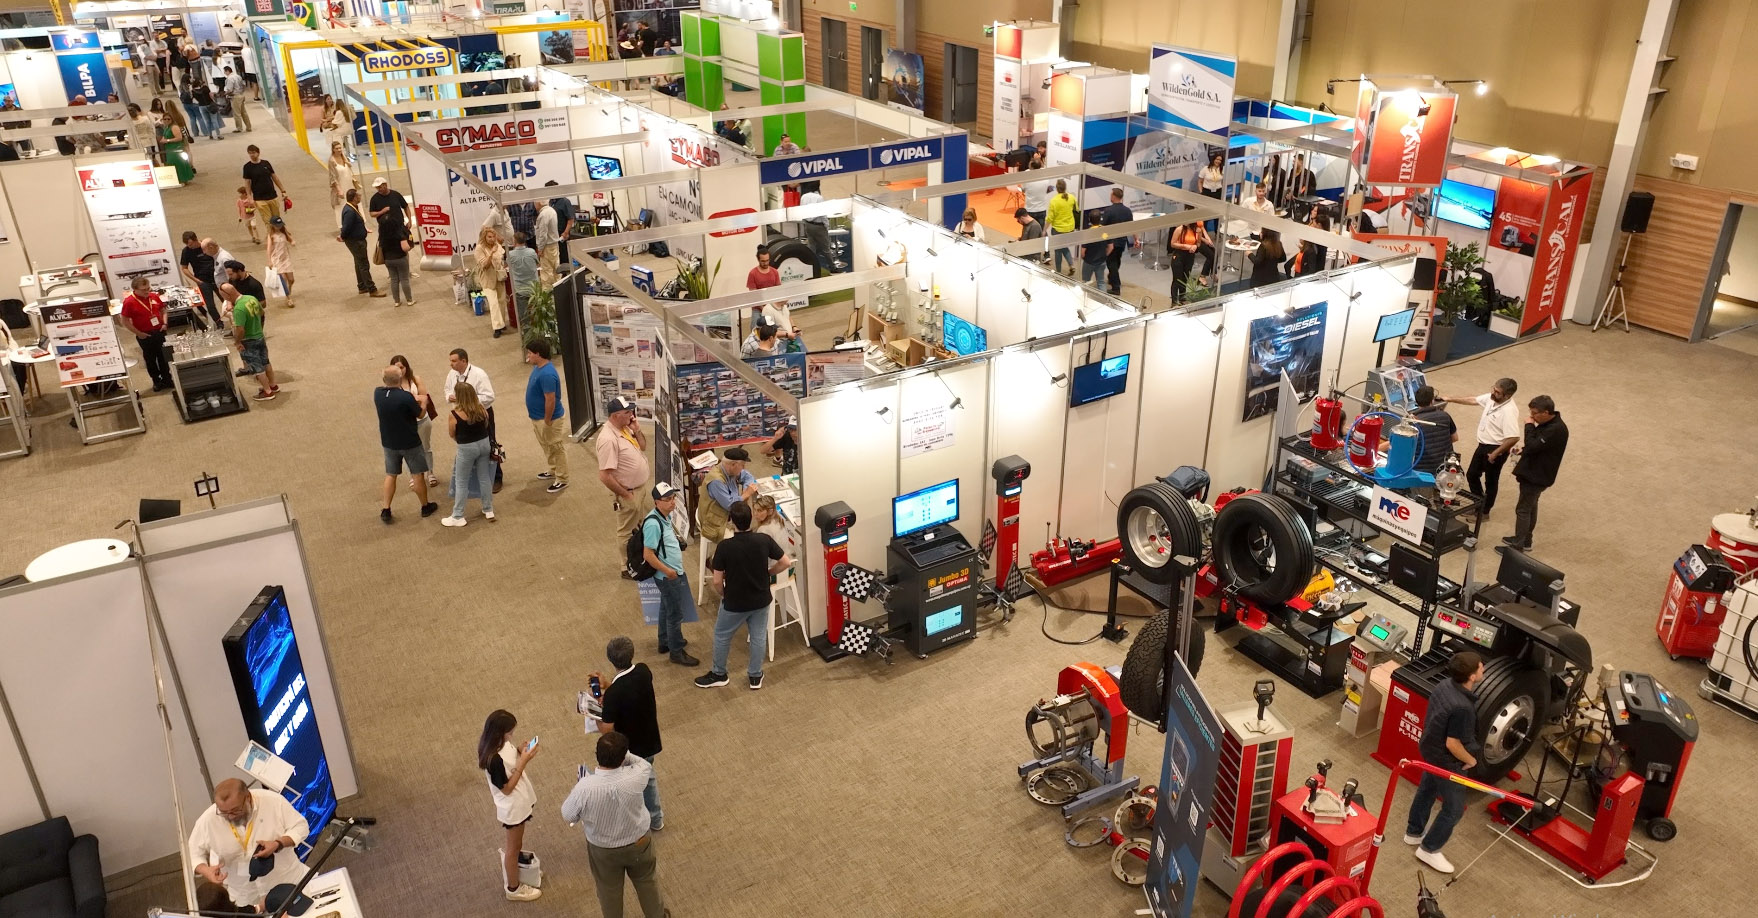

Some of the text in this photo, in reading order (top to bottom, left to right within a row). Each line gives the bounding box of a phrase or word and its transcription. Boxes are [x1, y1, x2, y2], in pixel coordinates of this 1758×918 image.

[368, 51, 446, 69] RHODOSS
[77, 62, 97, 98] BILPA
[436, 119, 536, 147] CYMACO
[894, 145, 932, 162] VIPAL
[802, 157, 844, 175] VIPAL
[1499, 211, 1512, 223] 45
[423, 226, 448, 238] 15%
[49, 313, 73, 322] ALVICE
[1284, 316, 1321, 334] DIESEL
[938, 572, 960, 584] Jumbo
[946, 576, 968, 587] OPTIMA
